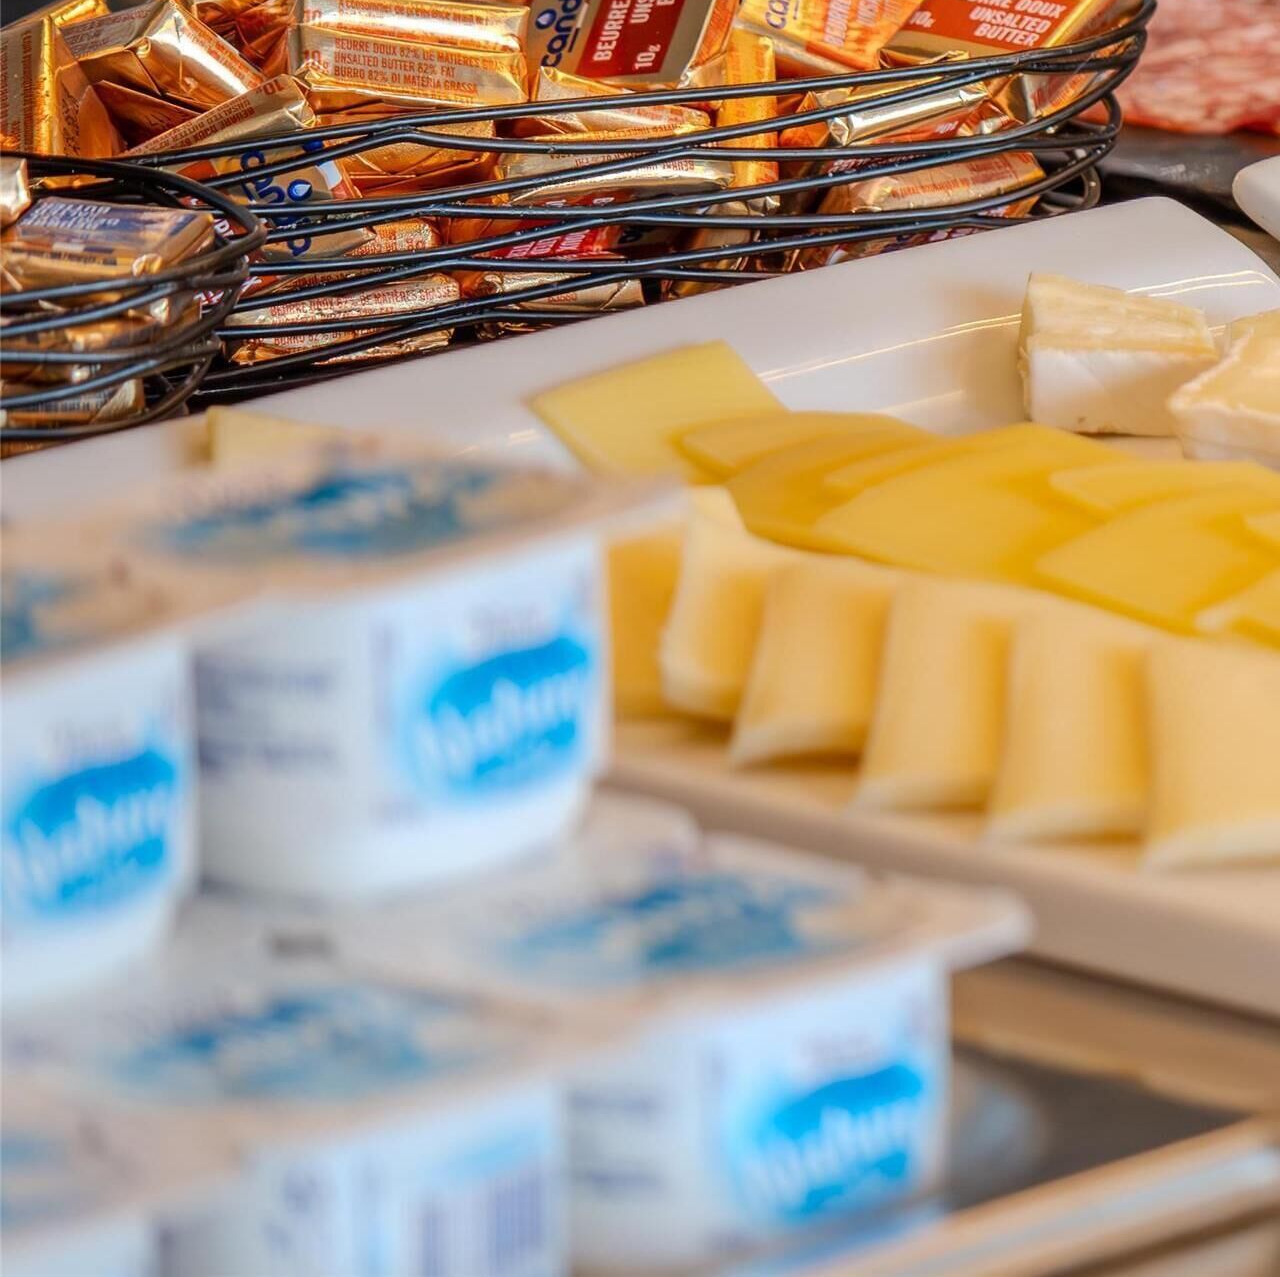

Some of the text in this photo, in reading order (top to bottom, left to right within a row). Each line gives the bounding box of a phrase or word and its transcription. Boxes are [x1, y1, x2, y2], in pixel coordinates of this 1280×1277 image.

[969, 6, 1051, 34] UNSALTED
[974, 23, 1040, 47] BUTTER
[335, 38, 369, 52] BEURRE
[373, 43, 397, 56] DOUX
[334, 52, 379, 68] UNSALTED
[381, 58, 415, 72] BUTTER
[334, 66, 366, 79] BURRO
